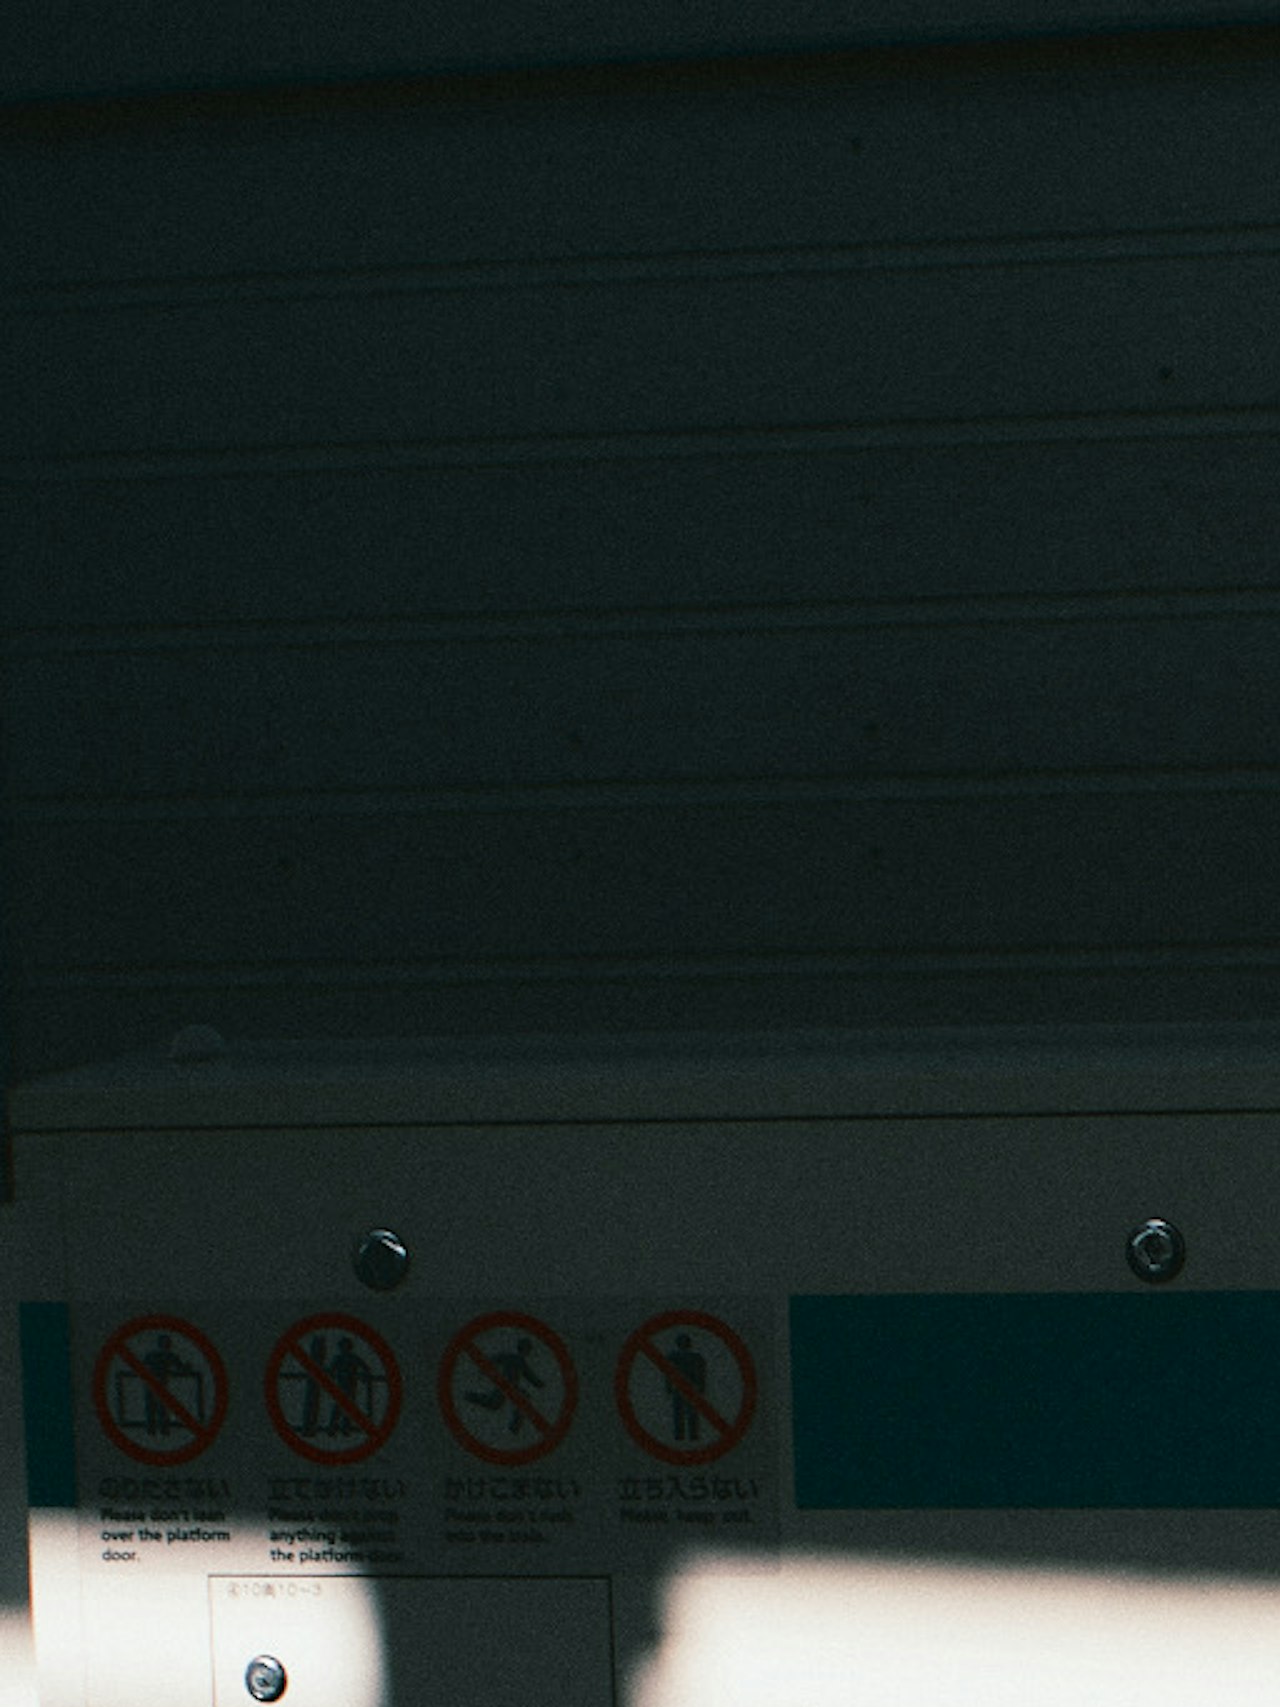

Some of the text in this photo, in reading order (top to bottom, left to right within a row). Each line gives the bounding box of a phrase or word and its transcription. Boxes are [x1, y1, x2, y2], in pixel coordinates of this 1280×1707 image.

[617, 1476, 759, 1501] 立ち入らない
[102, 1528, 231, 1545] over the platform
[271, 1529, 335, 1544] anything
[102, 1550, 141, 1562] door.
[271, 1550, 294, 1562] the
[299, 1549, 364, 1565] platform
